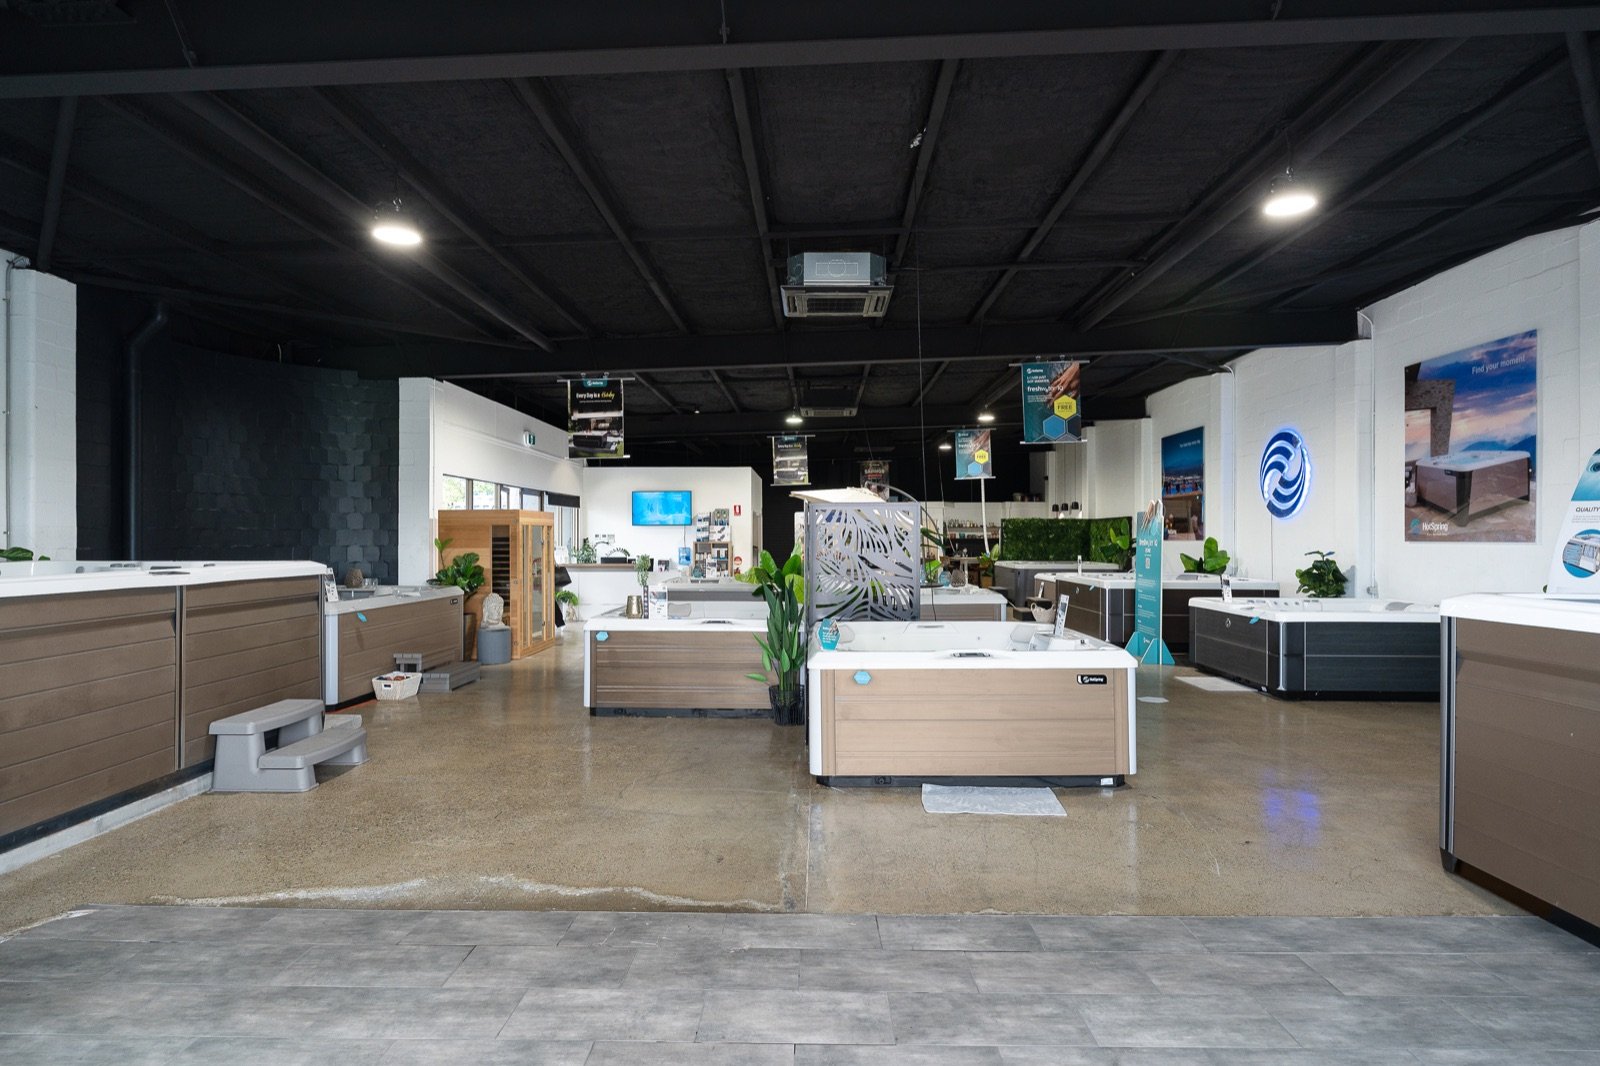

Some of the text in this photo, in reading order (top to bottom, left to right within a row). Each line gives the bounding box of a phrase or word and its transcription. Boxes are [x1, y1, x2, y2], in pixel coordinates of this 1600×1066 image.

[1471, 354, 1525, 374] Find your moment
